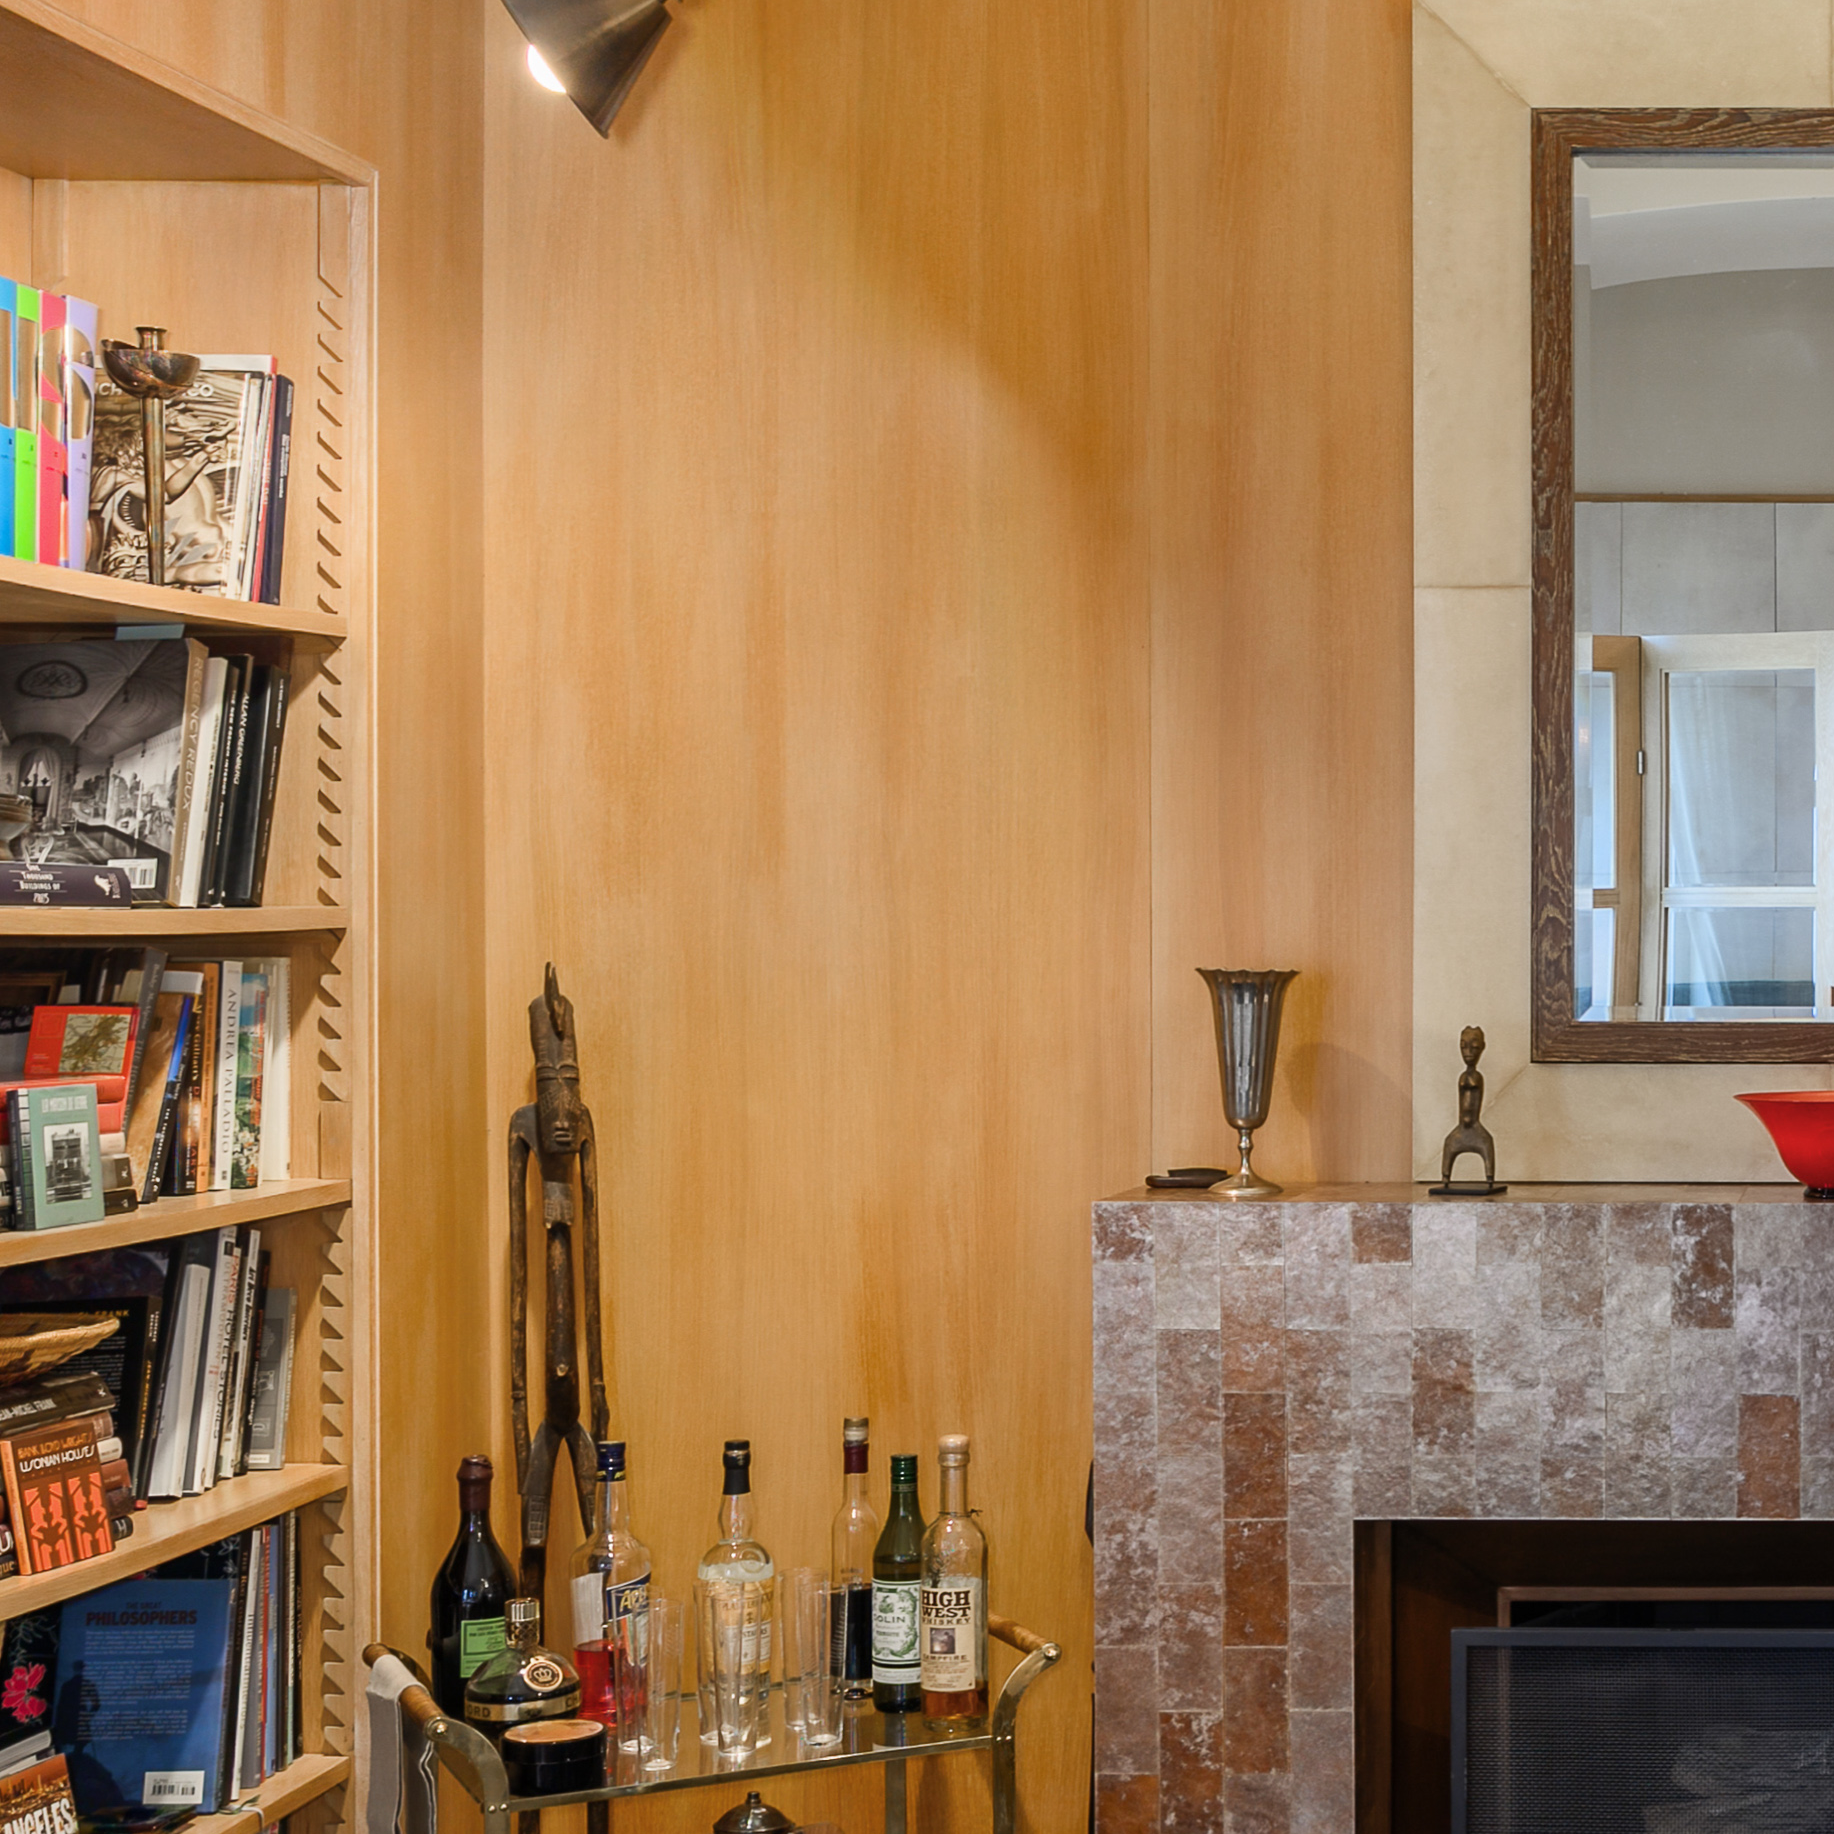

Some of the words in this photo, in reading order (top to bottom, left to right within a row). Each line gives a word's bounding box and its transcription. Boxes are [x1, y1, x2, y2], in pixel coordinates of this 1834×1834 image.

[185, 656, 206, 744] REGENCY
[230, 689, 238, 704] THE
[237, 691, 252, 726] ALLAN
[227, 706, 236, 723] NEW
[224, 725, 233, 756] FRENCH
[229, 727, 248, 785] GREENBERG
[180, 747, 196, 812] REDUX
[220, 758, 230, 795] INTERIOR
[223, 989, 238, 1060] ANDREA
[132, 1038, 145, 1061] THE
[219, 1068, 234, 1153] PALLADIO
[226, 1255, 241, 1304] PARIS
[247, 1266, 256, 1281] Art
[245, 1282, 254, 1303] Deco
[211, 1260, 232, 1359] ULTRAMODERN
[241, 1304, 251, 1340] Interiors
[220, 1308, 234, 1365] HOTEL
[0, 1403, 37, 1421] EAN-MICHEL
[211, 1370, 227, 1439] STORIES
[138, 1413, 146, 1439] FRANK
[17, 1445, 41, 1459] FRANK
[40, 1440, 60, 1455] LLOYD
[19, 1453, 61, 1473] USONIAN
[61, 1444, 95, 1463] HOUSES
[240, 1550, 248, 1571] THE
[239, 1575, 247, 1597] RUG
[921, 1590, 970, 1607] HIGH
[85, 1609, 198, 1626] PHILOSOPHERS
[234, 1599, 245, 1651] COMPANY
[922, 1606, 971, 1618] WEST
[922, 1617, 971, 1625] WHISKEY
